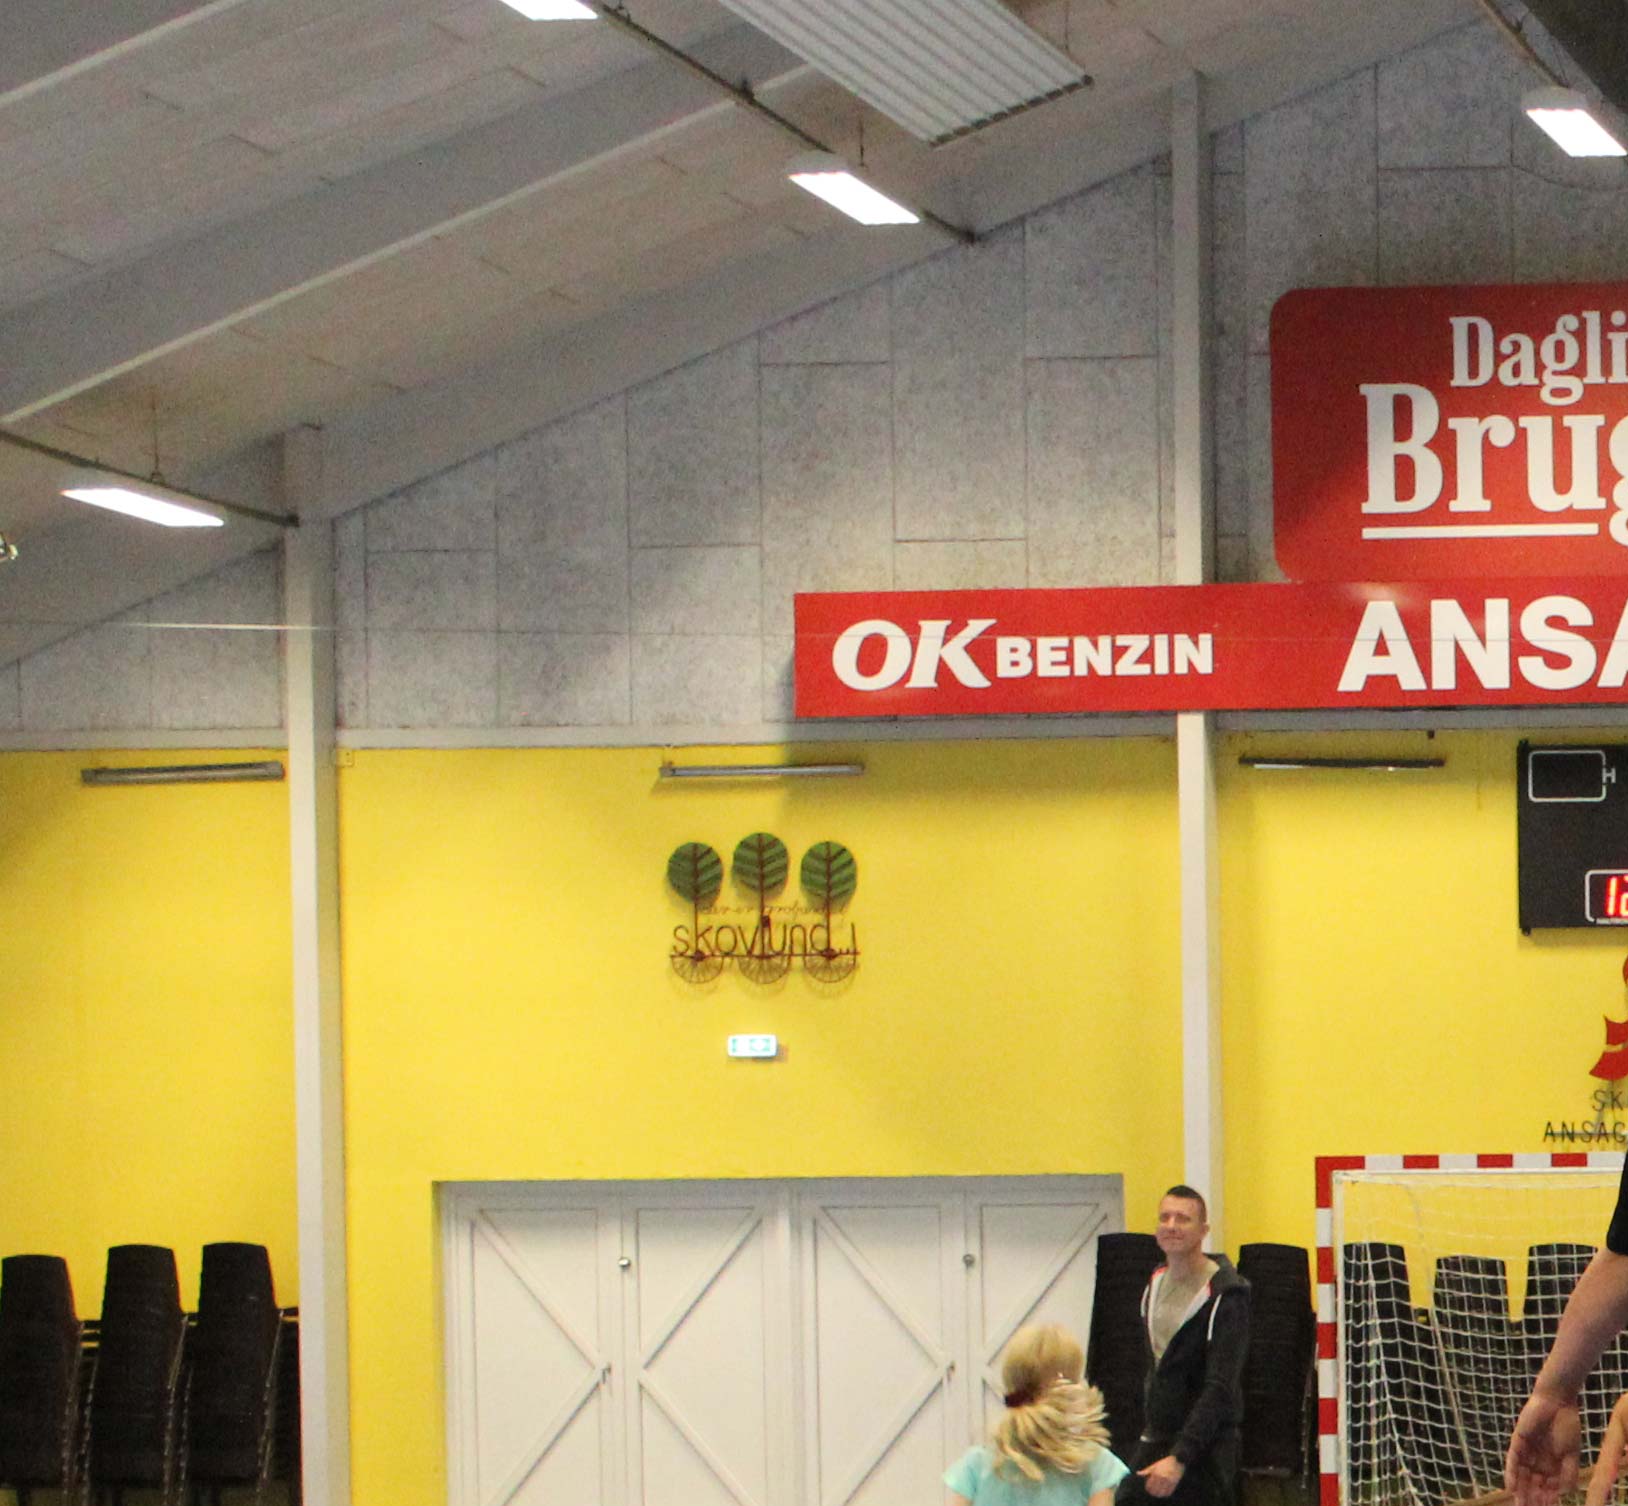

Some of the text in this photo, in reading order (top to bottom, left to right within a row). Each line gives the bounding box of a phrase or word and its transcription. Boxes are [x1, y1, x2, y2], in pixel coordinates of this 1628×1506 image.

[832, 619, 997, 691] OK
[996, 633, 1213, 678] BENZIN
[1603, 768, 1617, 785] H
[1543, 1121, 1628, 1144] ANSAG
